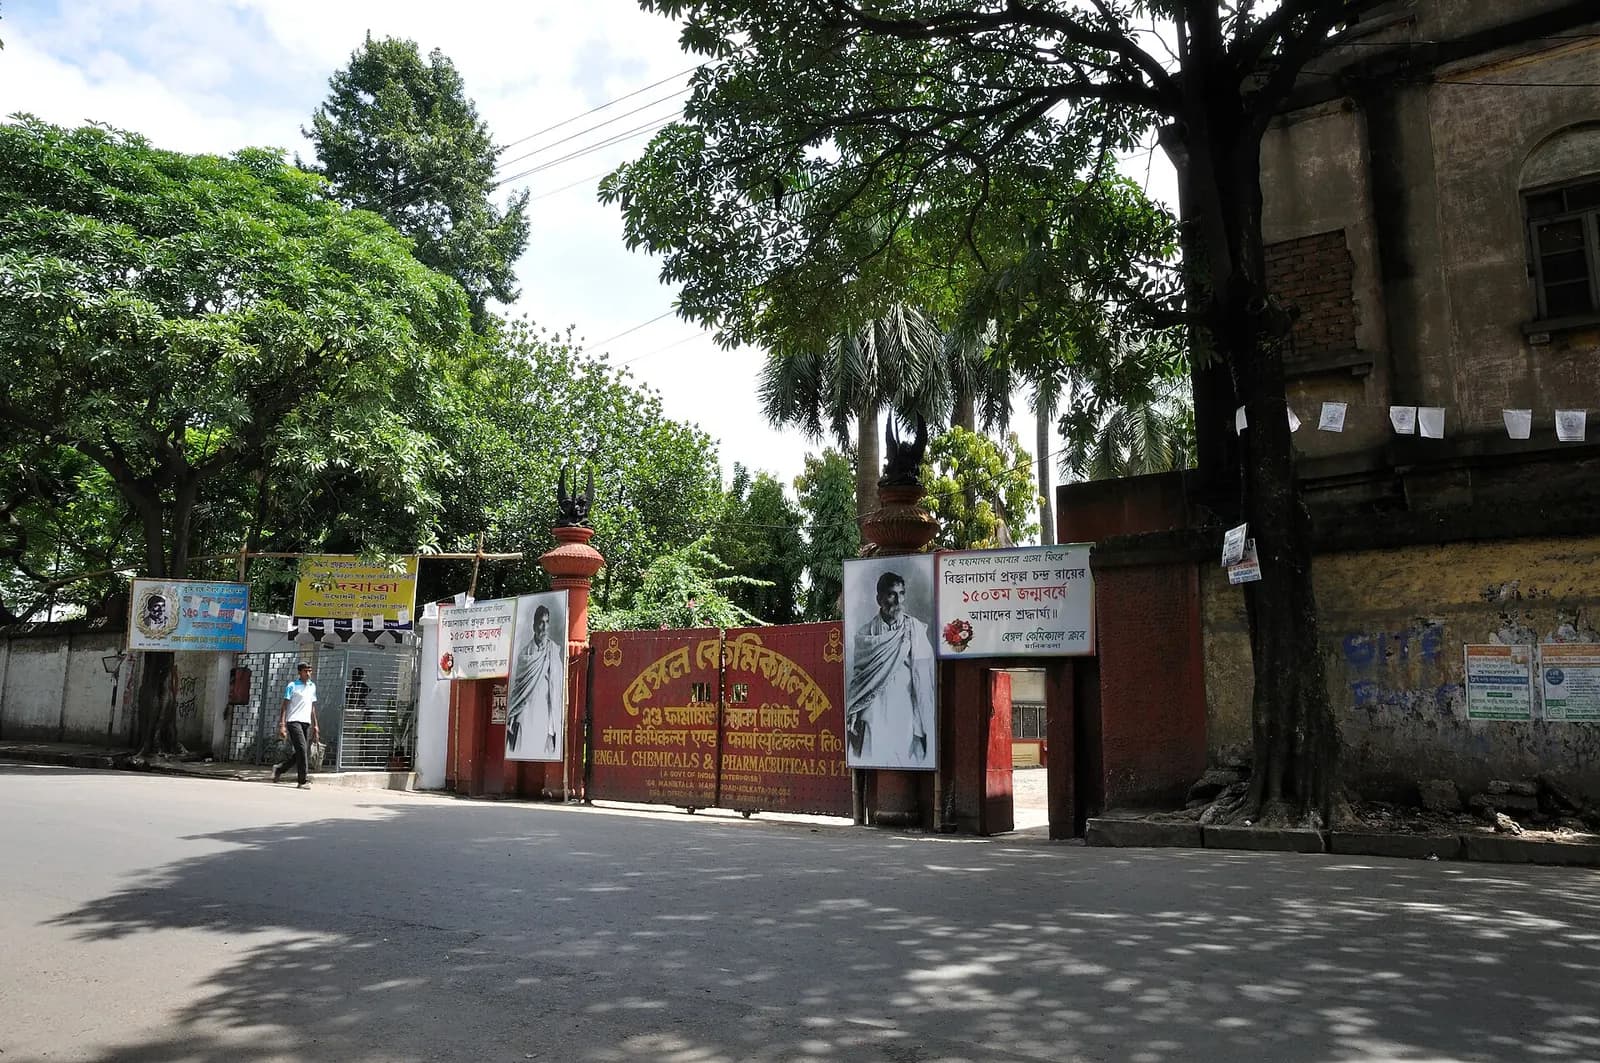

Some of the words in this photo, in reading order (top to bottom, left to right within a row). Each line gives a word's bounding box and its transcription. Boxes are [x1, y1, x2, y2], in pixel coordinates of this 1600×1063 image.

[994, 554, 1020, 565] আবার
[1022, 554, 1041, 563] এসো
[944, 569, 997, 585] বিজ্ঞানাচার্য
[1000, 569, 1028, 586] প্রফুল্ল
[1032, 570, 1050, 581] চন্দ্র
[1054, 568, 1086, 580] রায়ের
[323, 581, 400, 593] দযাত্রা
[962, 587, 1011, 603] ১৫০তম
[1016, 582, 1068, 602] জন্মবর্ষে
[968, 609, 1011, 622] আমাদের
[1002, 631, 1023, 643] বেঙ্গল
[1025, 627, 1065, 642] কেমিক্যাল
[1068, 630, 1087, 641] ক্লাব
[603, 726, 632, 745] बंगाल
[634, 724, 687, 747] केमिकल्स
[691, 730, 718, 748] एण्ड
[594, 750, 629, 767] ENGAL
[631, 751, 700, 769] CHEMICALS
[703, 754, 714, 770] &
[722, 754, 825, 776] PHARMACEUTICALS
[697, 772, 716, 780] INDIA
